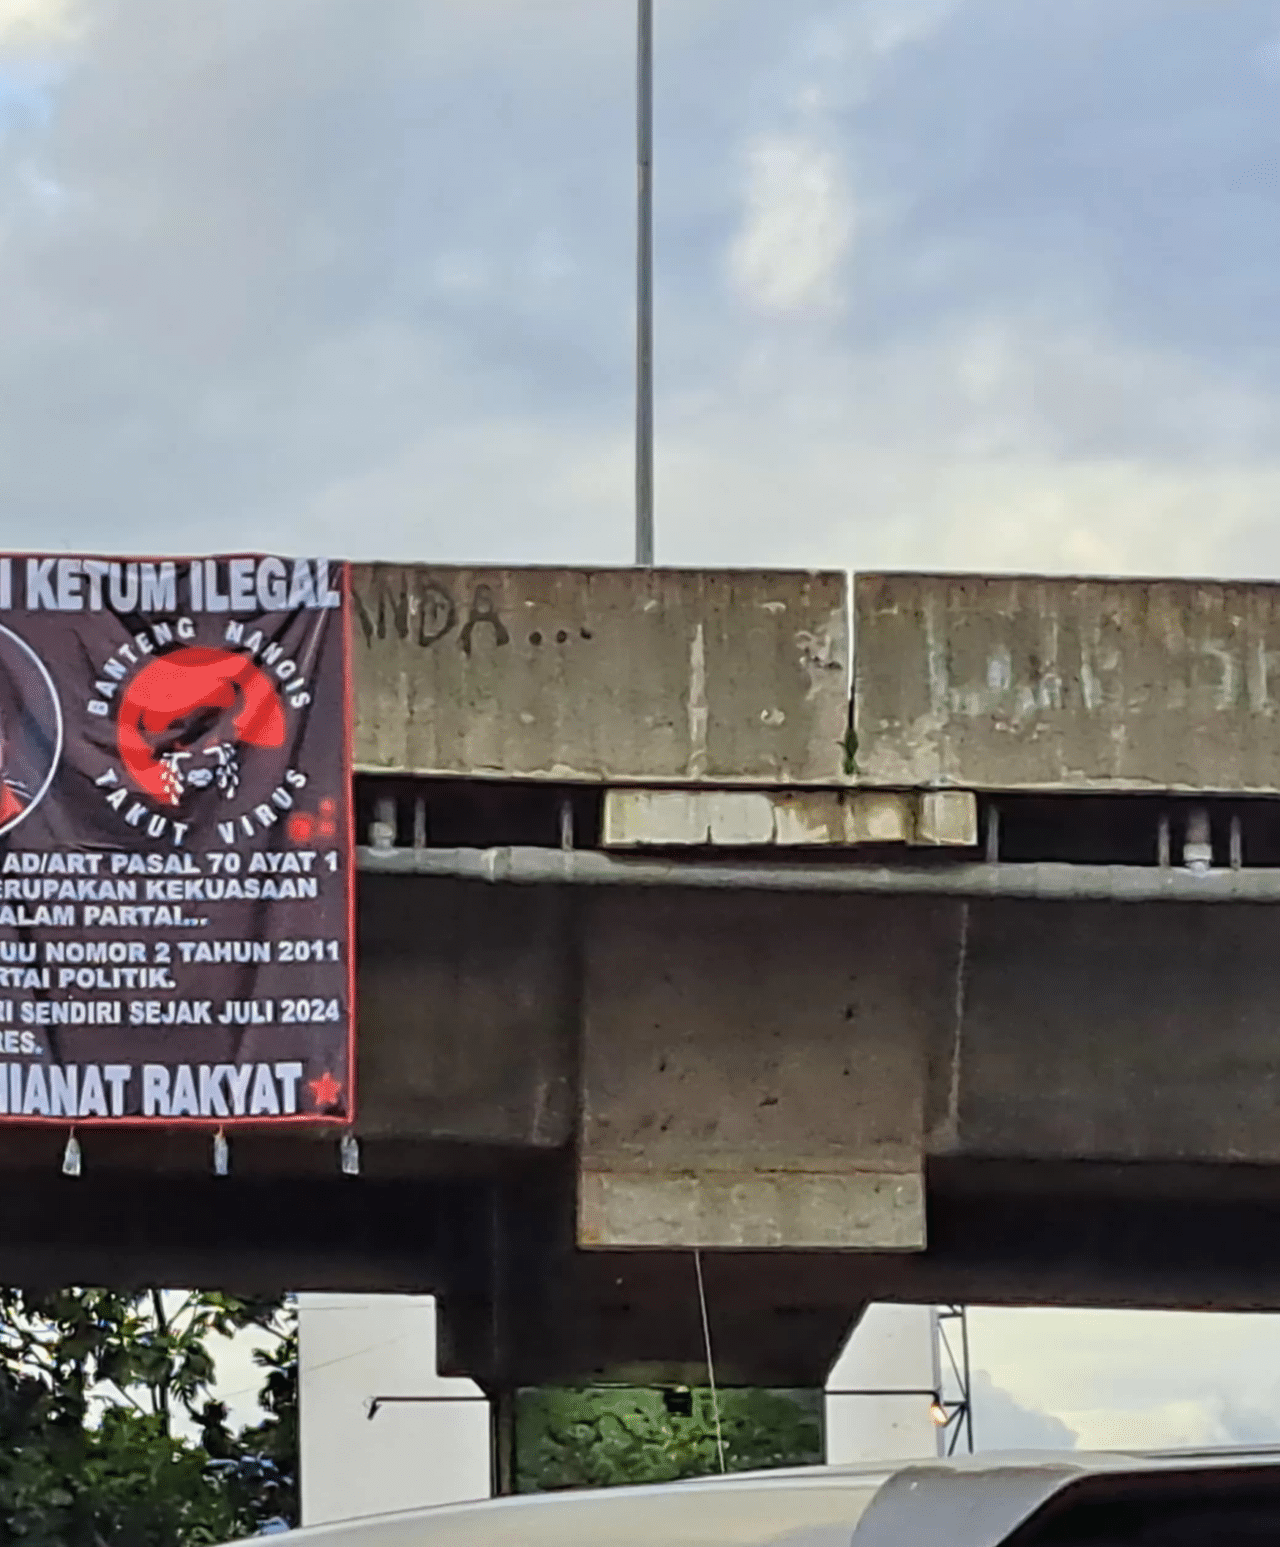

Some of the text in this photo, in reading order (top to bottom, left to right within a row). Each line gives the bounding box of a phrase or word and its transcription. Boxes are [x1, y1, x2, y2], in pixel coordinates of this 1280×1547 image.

[26, 557, 176, 612] KETUM
[190, 556, 341, 612] ILEGAL
[86, 616, 196, 717] BANTENG
[217, 768, 309, 844] VIRUS
[2, 853, 104, 875] AD/ART
[110, 853, 202, 875] PASAL
[206, 852, 242, 874] 70
[248, 851, 317, 874] AYAT
[323, 850, 338, 873] 1
[146, 877, 318, 901] KEKUASAAN
[0, 941, 37, 963] UU
[45, 941, 147, 965] NOMOR
[154, 941, 171, 964] 2
[177, 940, 271, 964] TAHUN
[277, 939, 340, 962] 2011
[58, 966, 177, 990] POLITIK.
[20, 1001, 121, 1025] SENDIRI
[129, 1000, 213, 1025] SEJAK
[218, 999, 274, 1025] JULI
[280, 998, 340, 1023] 2024
[142, 1061, 303, 1117] RAKYAT
